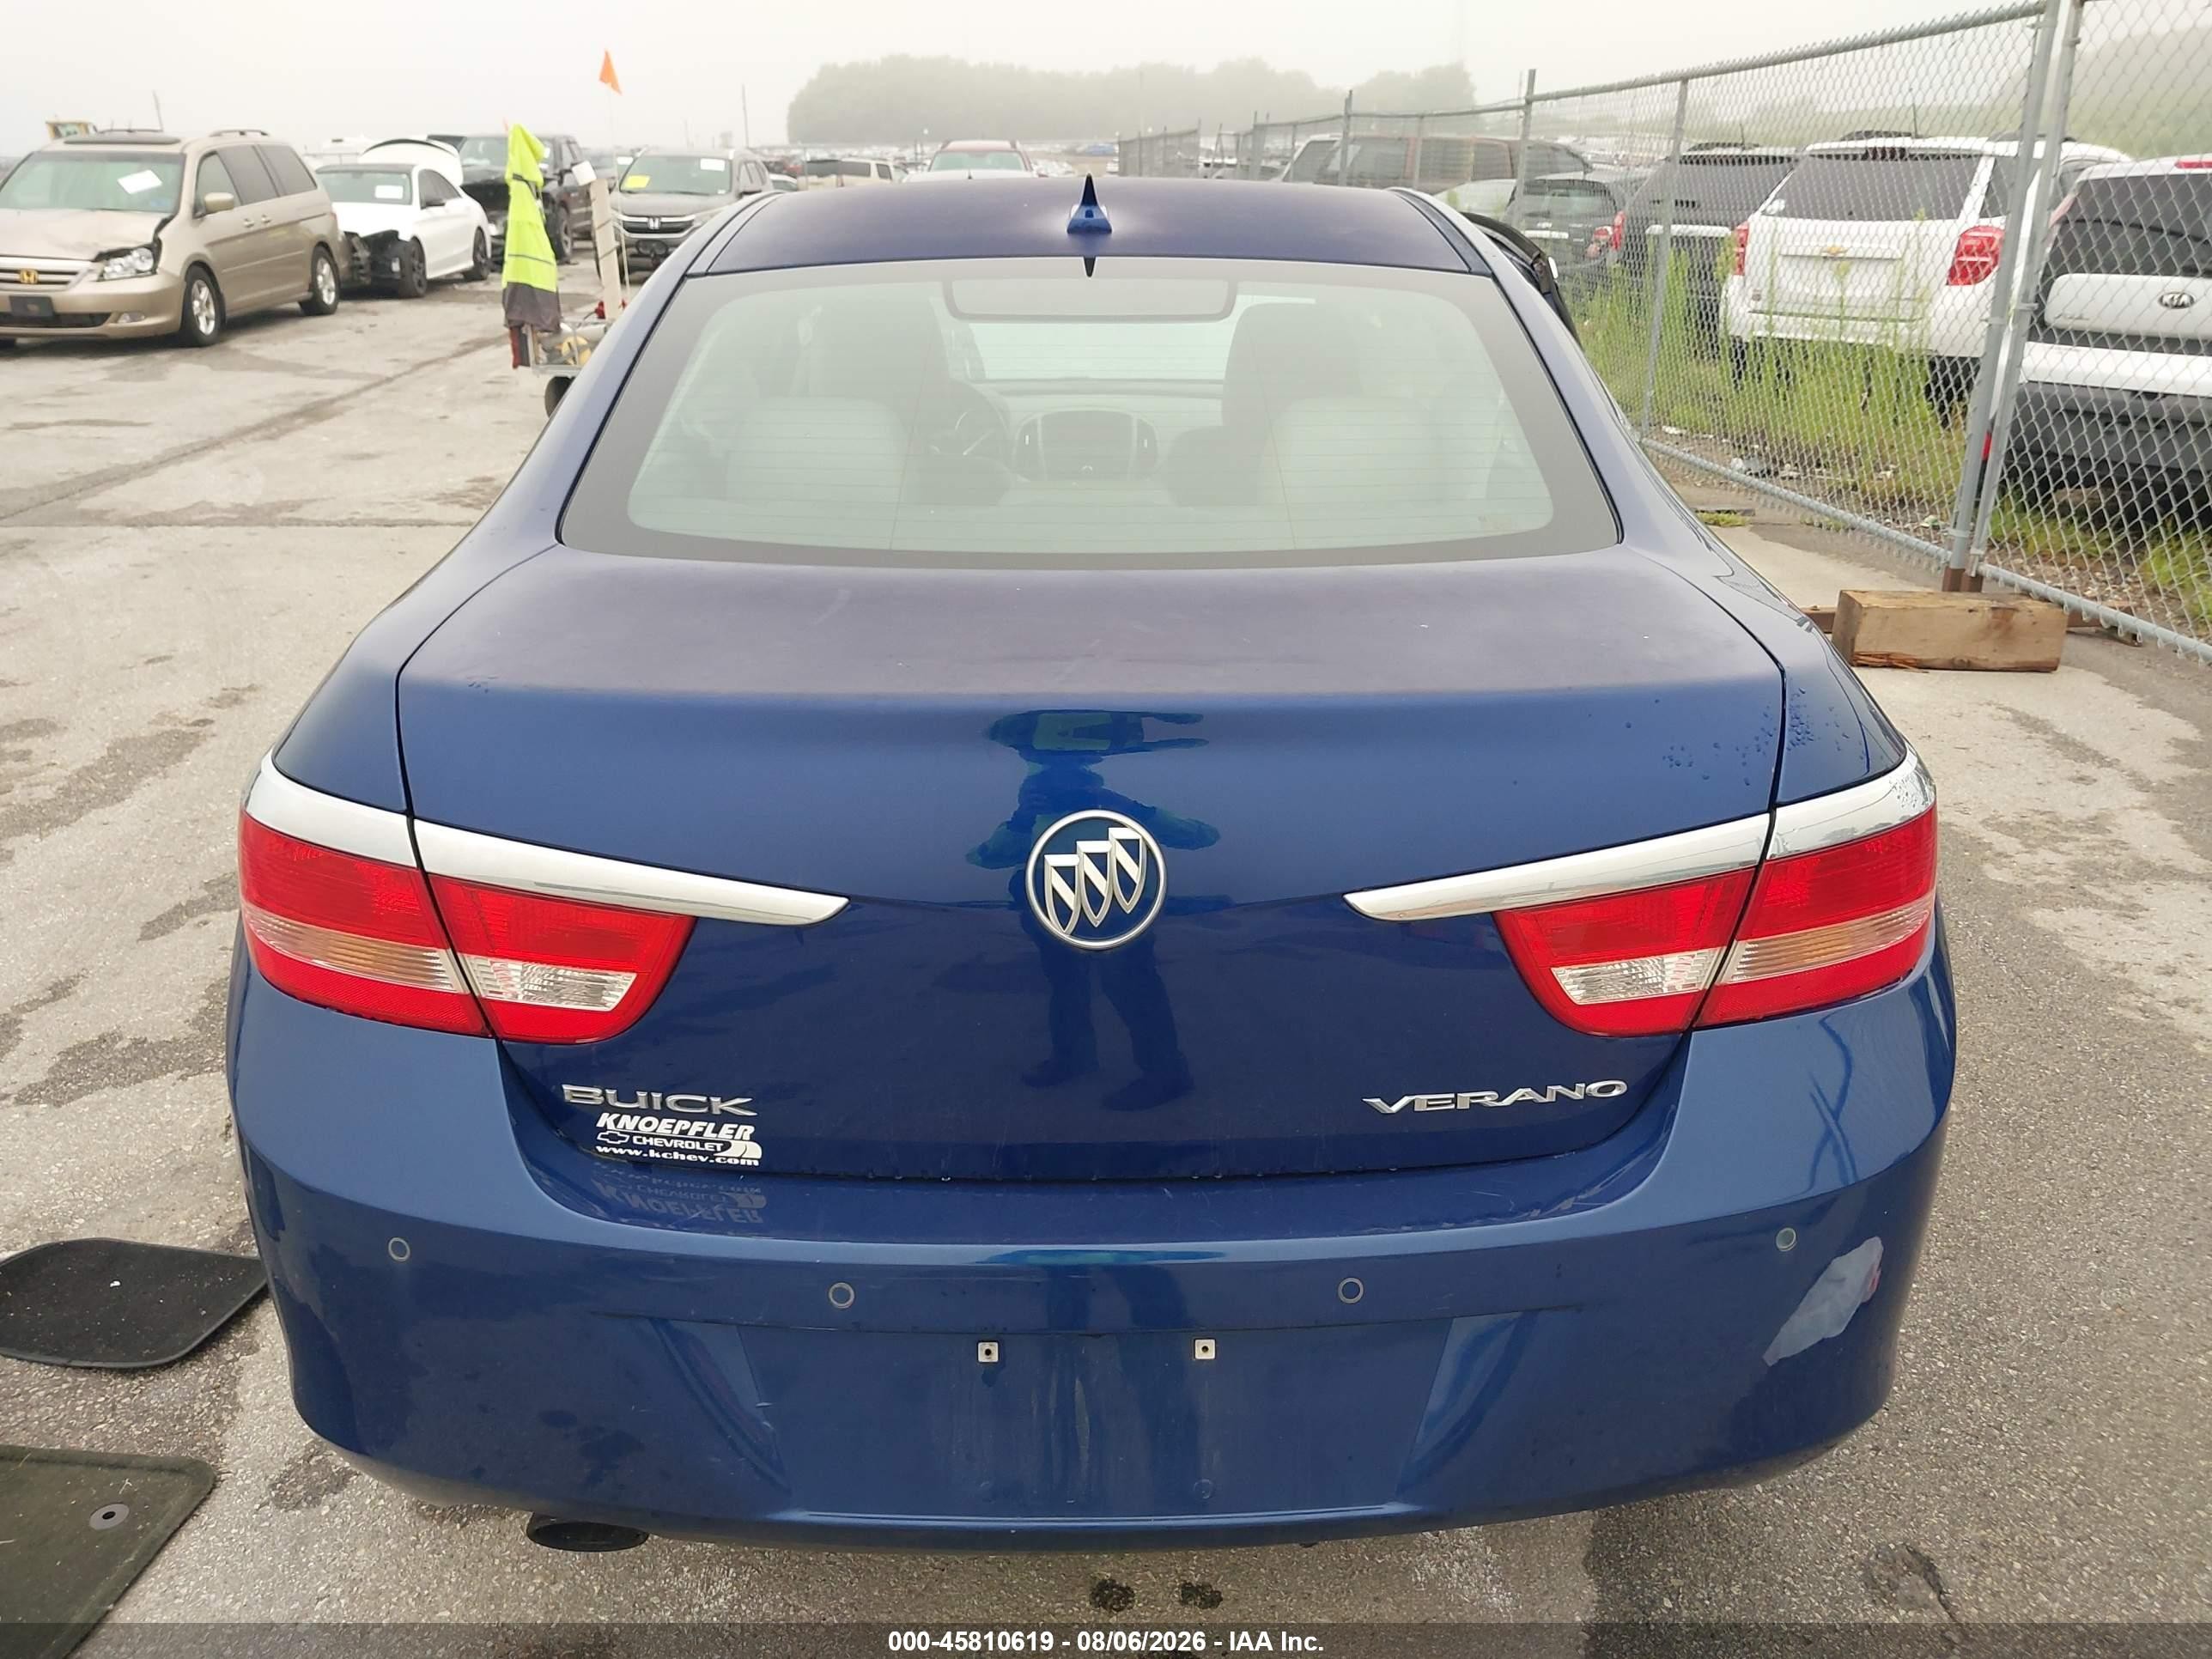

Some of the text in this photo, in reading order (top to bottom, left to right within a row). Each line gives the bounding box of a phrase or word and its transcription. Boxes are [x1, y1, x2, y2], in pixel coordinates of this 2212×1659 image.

[562, 1085, 757, 1116] BUICK
[1362, 1079, 1628, 1114] VERANO
[597, 1112, 755, 1141] KNOEPFLER
[596, 1146, 759, 1166] www.kchev.com
[632, 1134, 724, 1152] CHEVROLET
